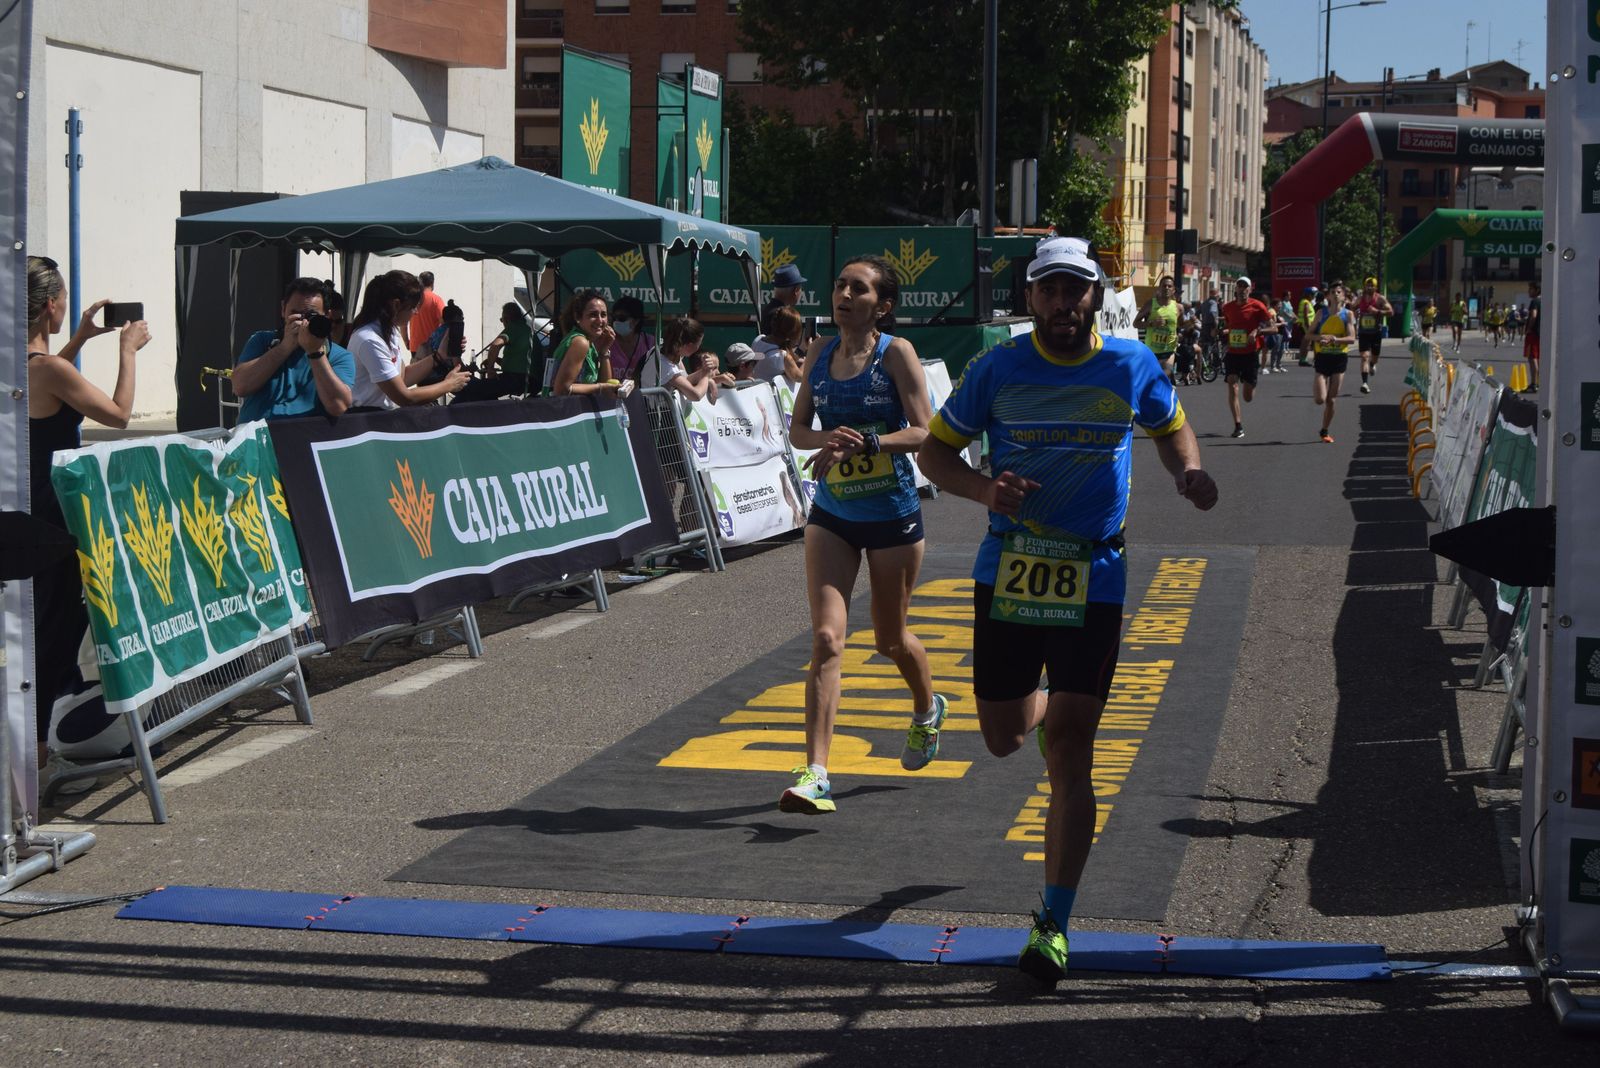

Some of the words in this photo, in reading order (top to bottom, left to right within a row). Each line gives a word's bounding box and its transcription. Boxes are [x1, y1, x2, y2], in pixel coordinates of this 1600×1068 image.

[1470, 127, 1499, 139] CON
[1503, 128, 1519, 139] EL
[1412, 138, 1454, 148] ZAMORA
[1469, 143, 1535, 156] GANAMOS
[1489, 218, 1526, 231] CAJA
[709, 289, 753, 305] CAJA
[759, 290, 820, 305] RAL
[901, 292, 964, 307] RURAL
[863, 479, 894, 491] RURAL
[443, 476, 521, 544] CAJA
[511, 461, 609, 531] RURAL
[1026, 537, 1080, 551] FUNDACION
[1025, 545, 1047, 555] CAJA
[1048, 548, 1079, 559] RURAL
[1005, 559, 1078, 598] 208
[1018, 607, 1040, 618] CAJA
[1043, 608, 1079, 619] RURAL
[167, 611, 199, 638] RURAL
[118, 632, 147, 660] URAL
[1098, 659, 1175, 731] INTEGRAL
[1141, 558, 1208, 604] INTERIORES
